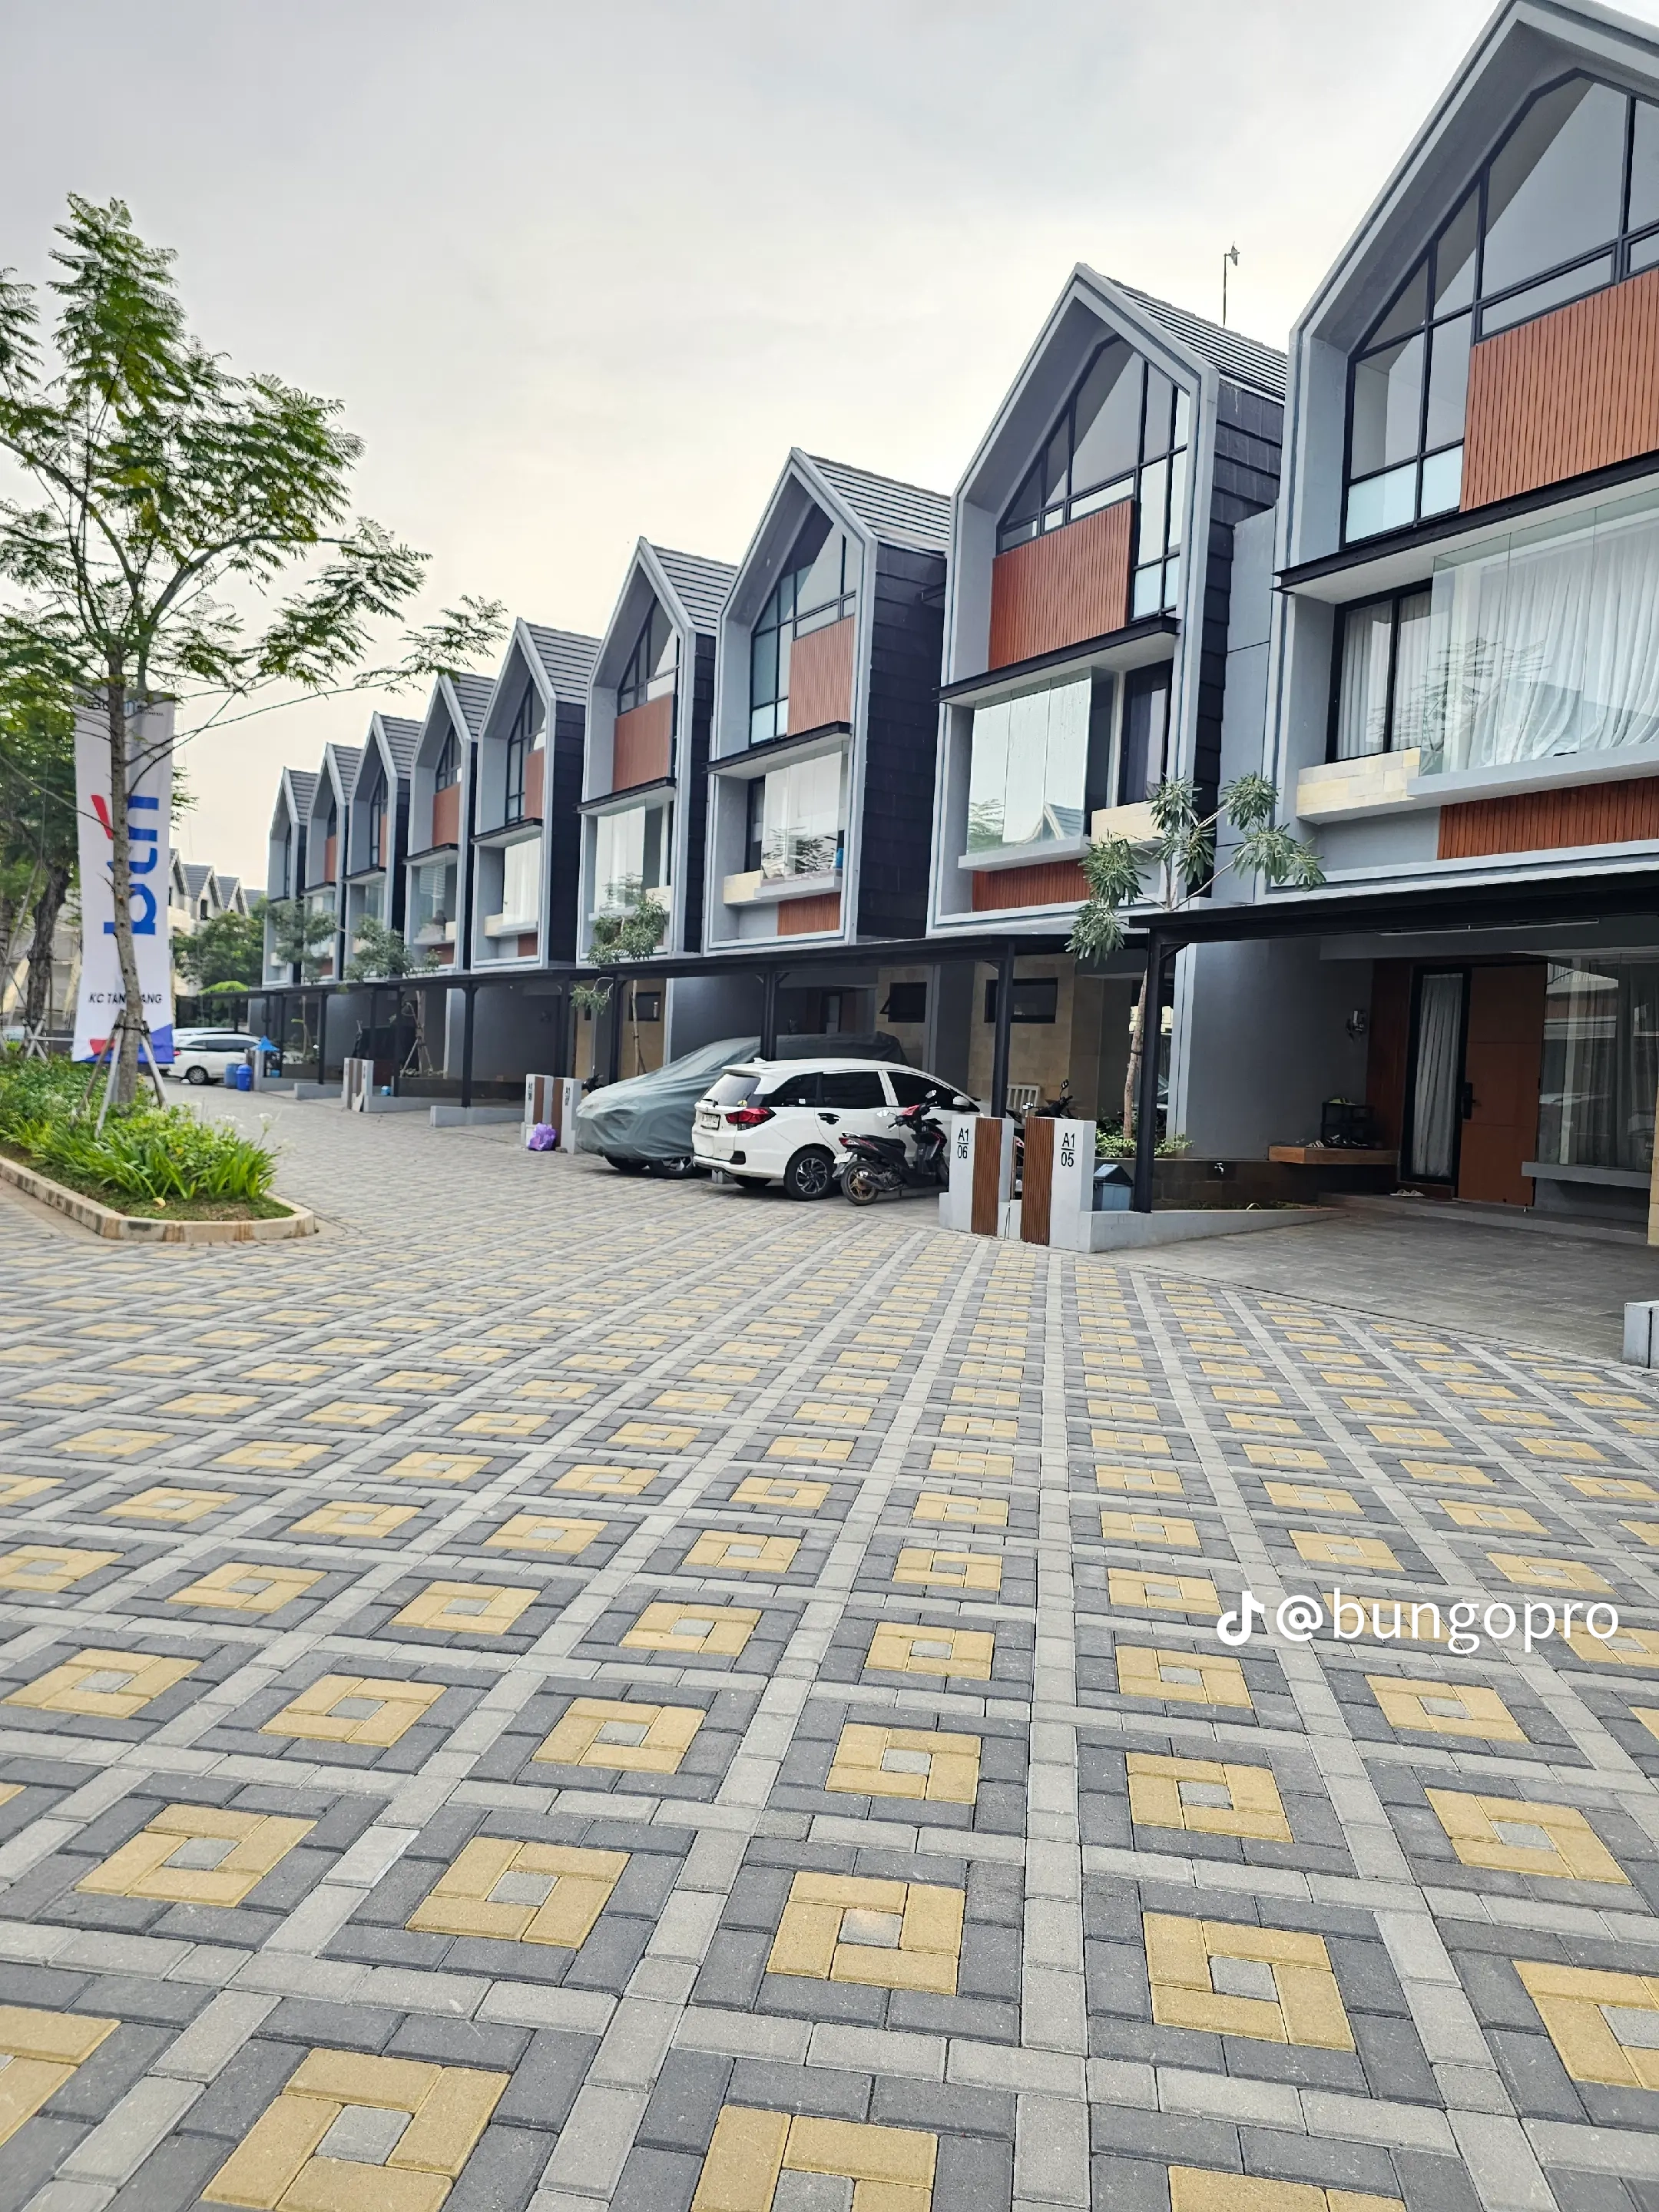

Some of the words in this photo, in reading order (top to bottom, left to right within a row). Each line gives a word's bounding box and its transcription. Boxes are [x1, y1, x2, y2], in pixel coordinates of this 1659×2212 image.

[89, 992, 104, 1004] KC
[107, 992, 162, 1004] TANANG
[958, 1128, 969, 1141] A1
[1062, 1132, 1075, 1148] A1
[957, 1144, 968, 1159] 06
[1061, 1151, 1075, 1167] 05
